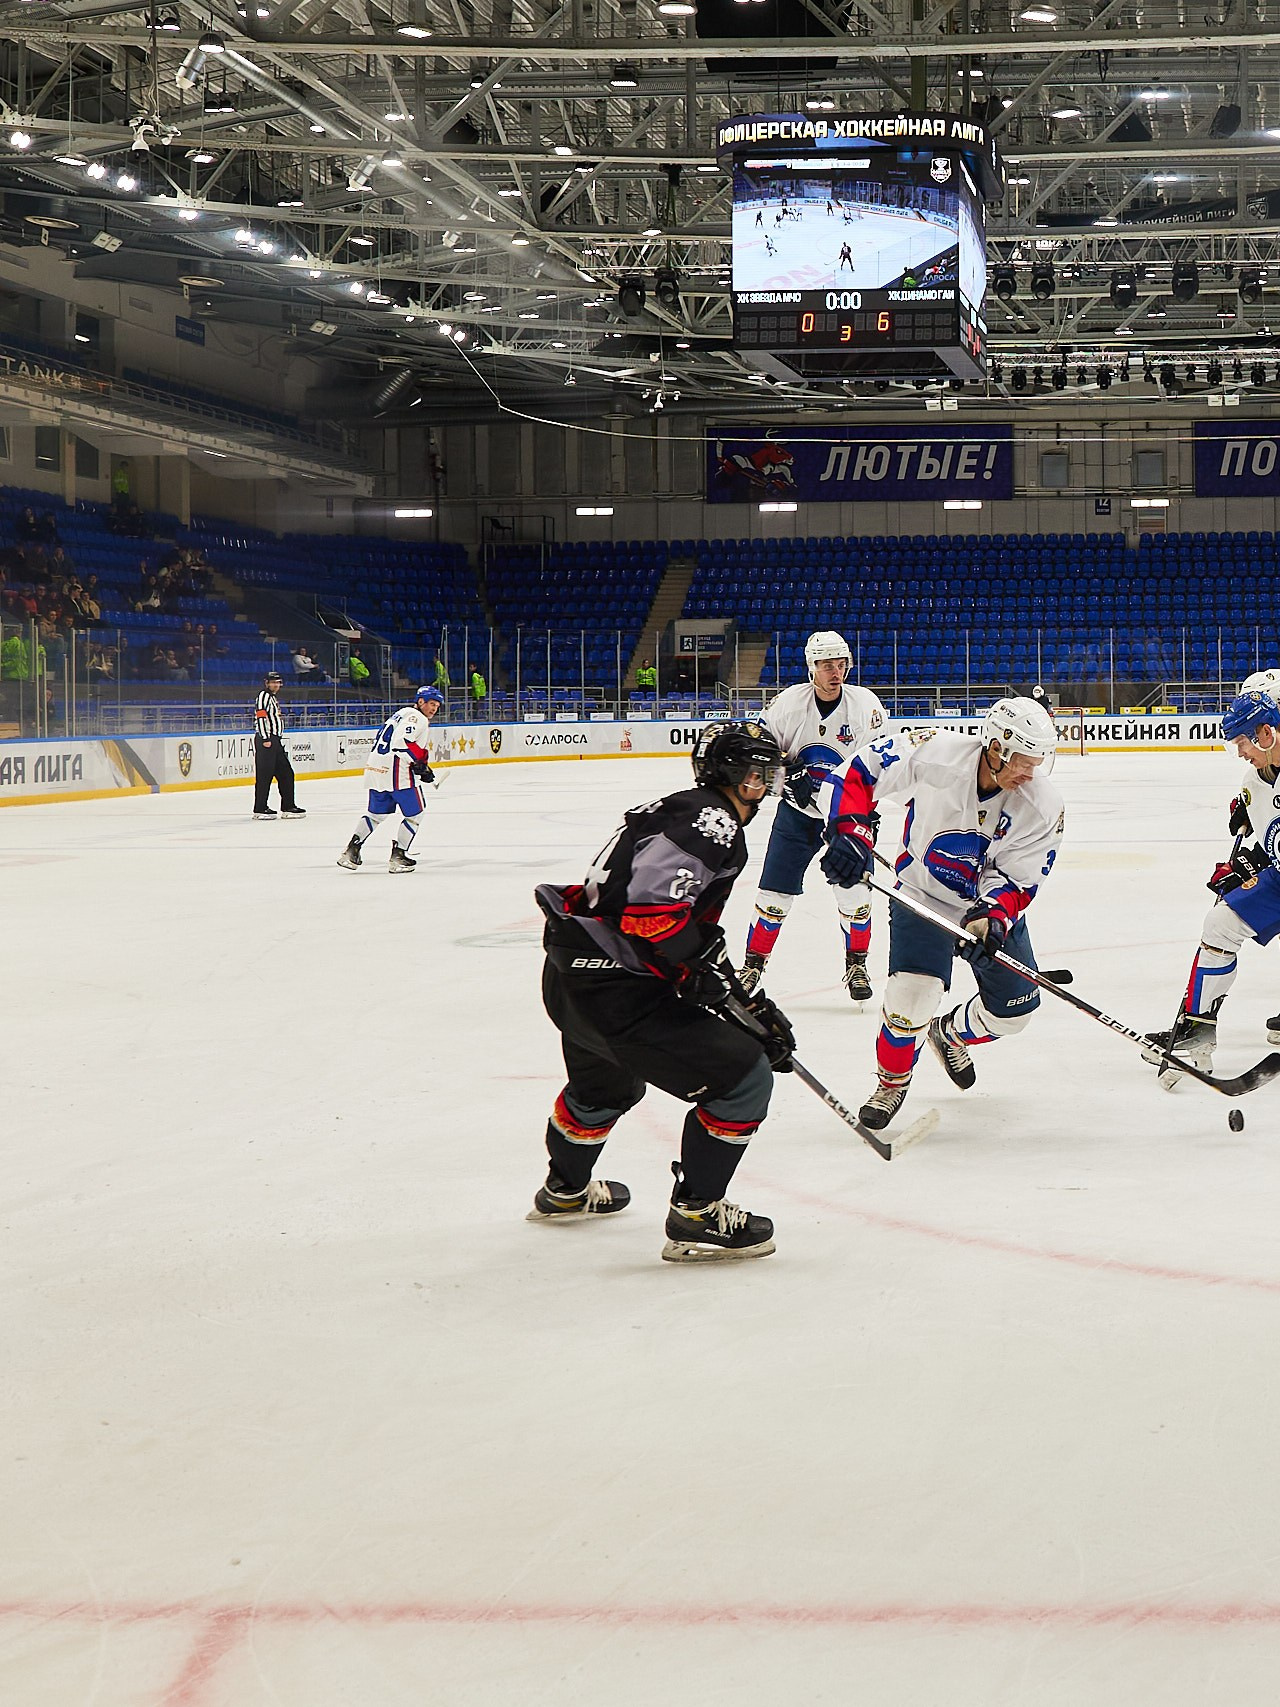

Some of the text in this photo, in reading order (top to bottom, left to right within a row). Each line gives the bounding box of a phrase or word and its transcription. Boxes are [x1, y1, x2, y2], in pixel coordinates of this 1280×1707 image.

[719, 114, 985, 146] ОФИЦЕРСКАЯ ХОККЕЙНАЯ ЛИГА
[825, 291, 862, 310] 0:00
[802, 313, 814, 333] 0
[877, 311, 890, 331] 6
[840, 325, 851, 342] 3
[820, 445, 998, 481] ЛЮТЫЕ!
[1056, 719, 1180, 741] ХОККЕЙНАЯ
[34, 753, 83, 783] ЛИГА
[751, 754, 771, 762] CCM
[571, 957, 624, 969] BAU
[1097, 1011, 1168, 1056] BAUER
[823, 1091, 859, 1129] CCM
